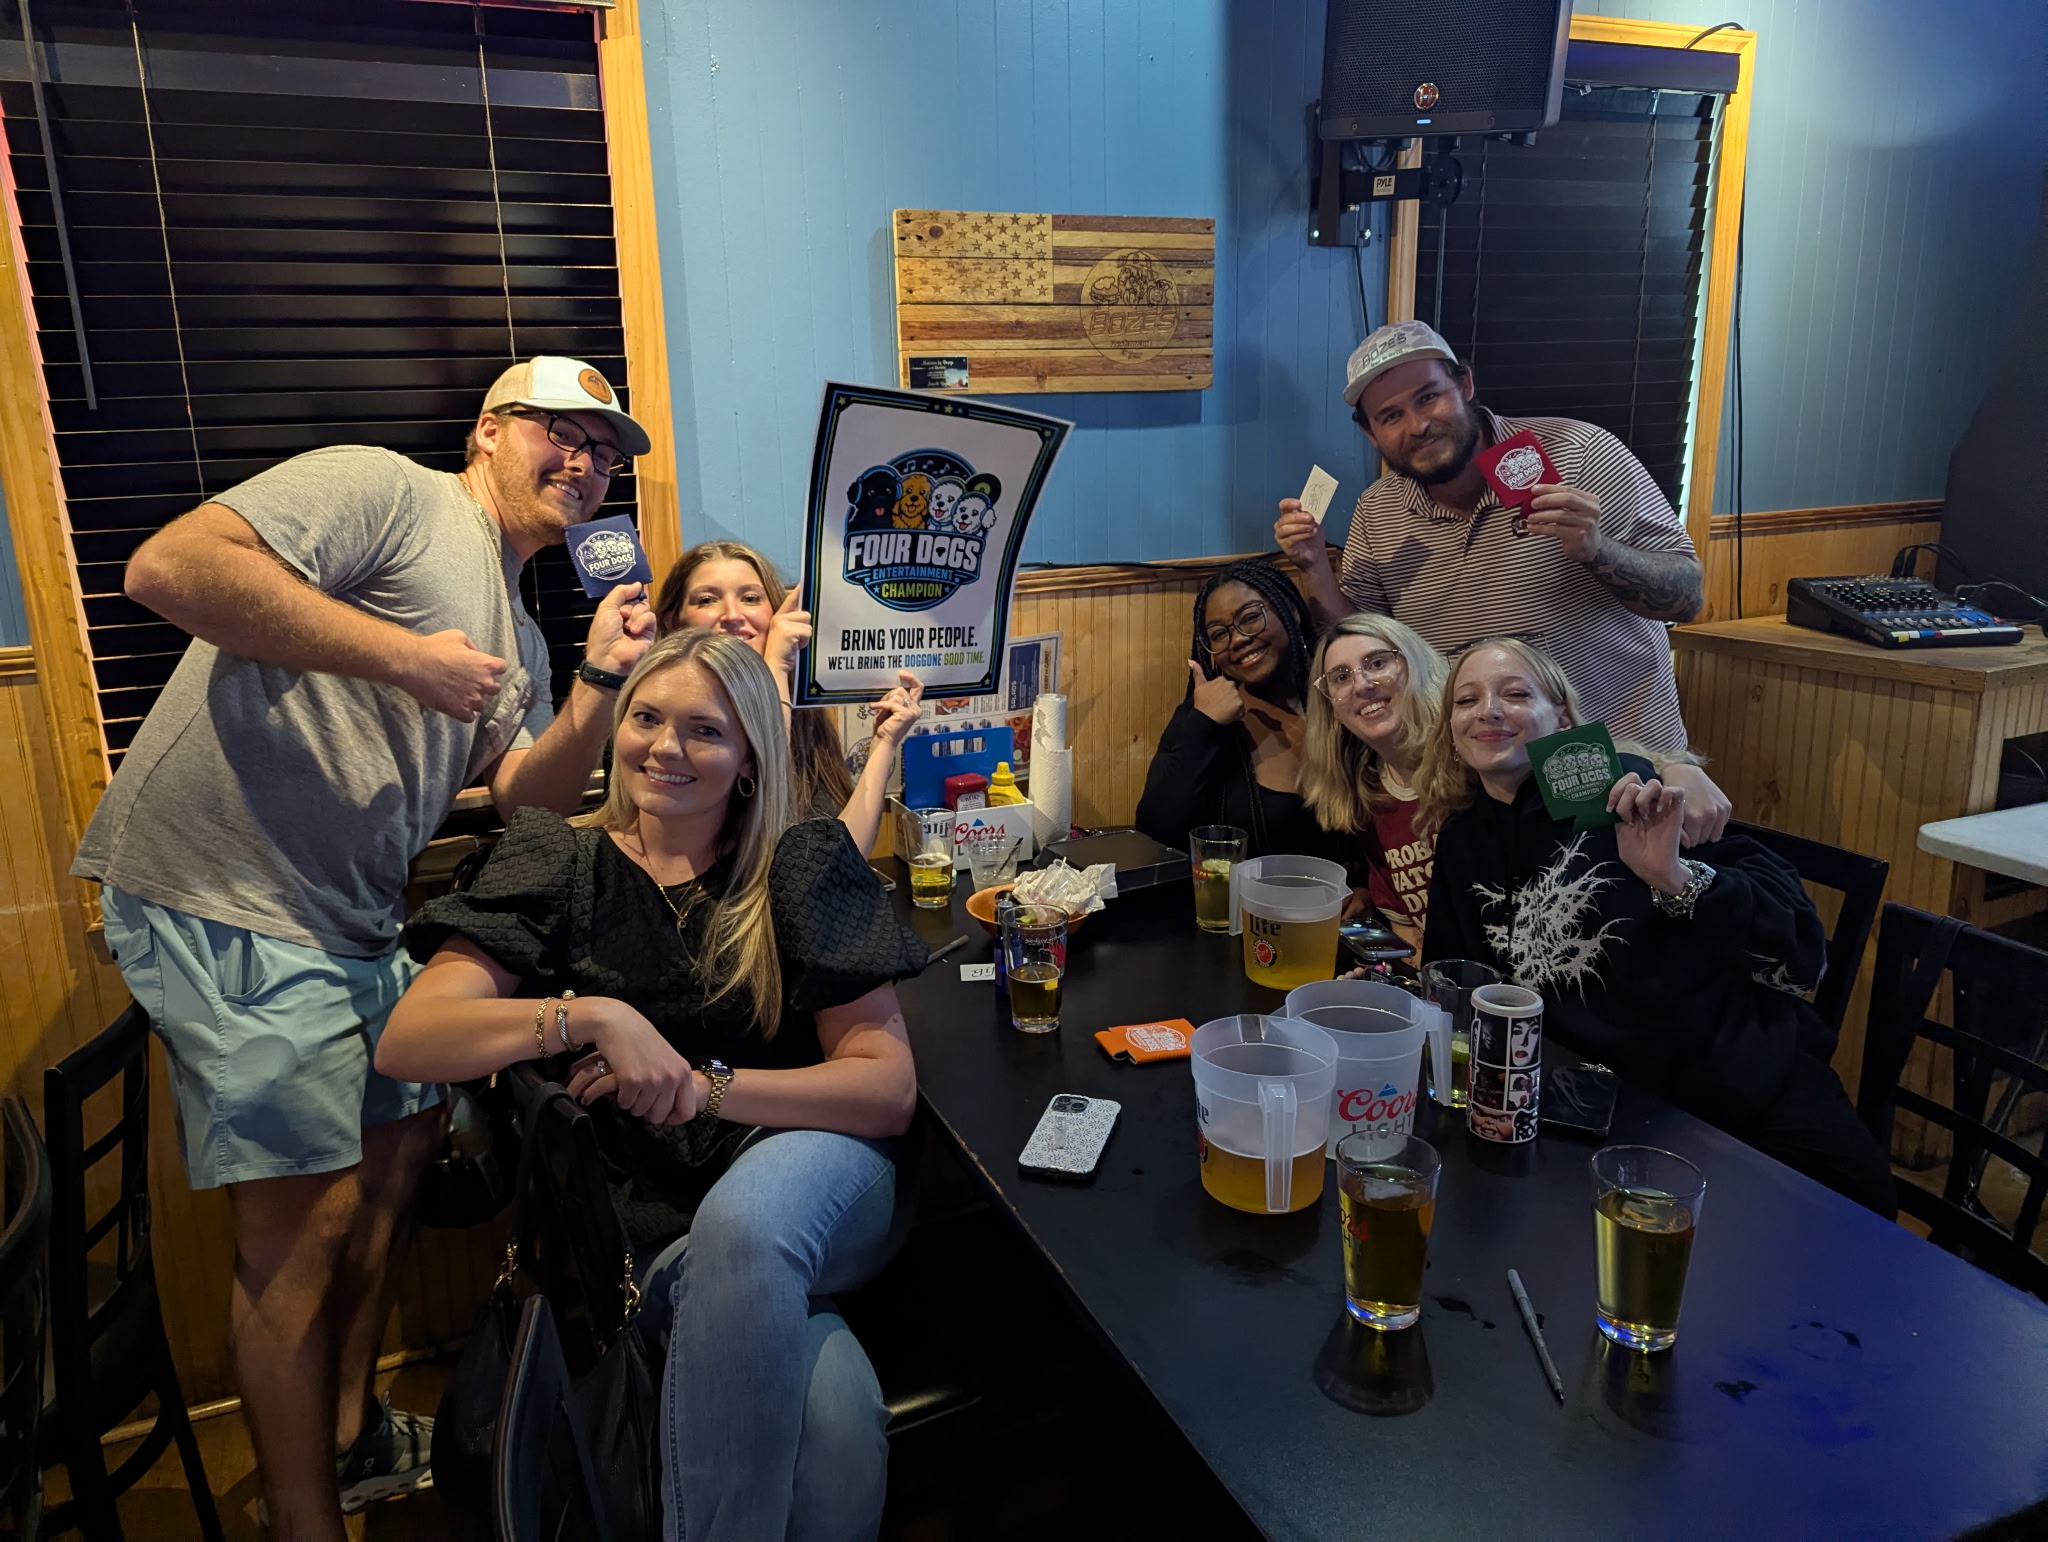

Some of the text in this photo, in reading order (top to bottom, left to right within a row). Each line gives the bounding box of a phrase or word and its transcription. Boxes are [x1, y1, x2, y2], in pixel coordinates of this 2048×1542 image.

[1376, 177, 1392, 188] PYLE
[1508, 472, 1524, 486] FOUR
[1523, 463, 1541, 476] DOGS
[589, 553, 632, 572] FOUR DOGS
[848, 533, 980, 571] FOUR DOGS
[872, 566, 953, 580] ENTERTAINMENT
[881, 583, 942, 598] CHAMPION
[841, 626, 978, 651] BRING YOUR PEOPLE.
[828, 650, 985, 670] WE'LL BRING THE DOGGONE GOOD TIME.
[1552, 768, 1611, 794] FOUR DOGS
[954, 822, 1006, 845] Coors
[1249, 912, 1281, 937] Lite
